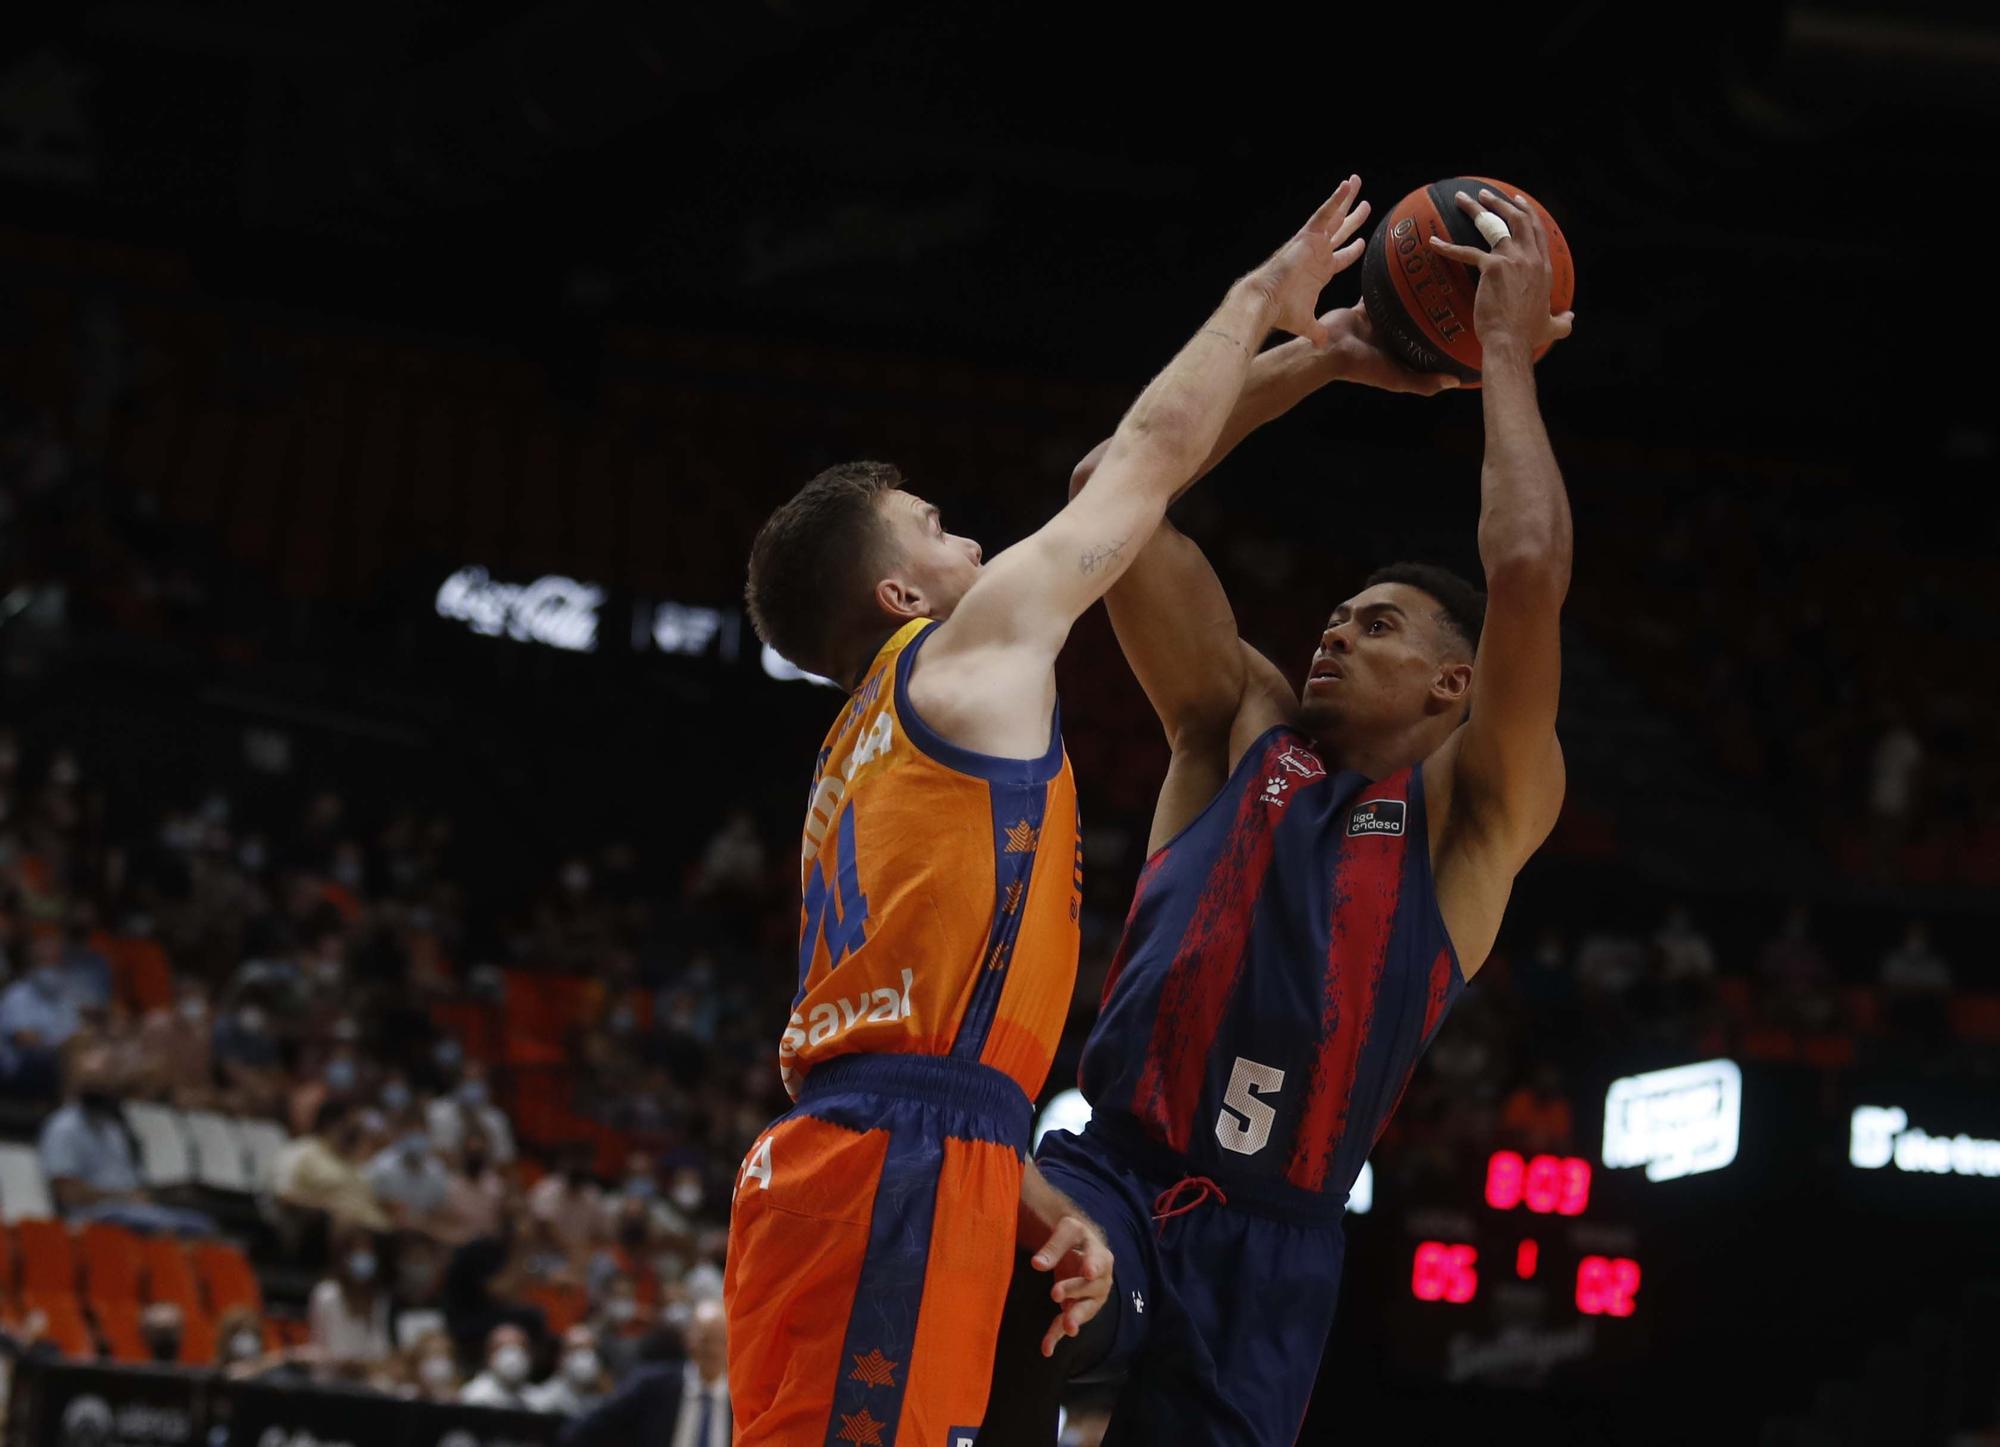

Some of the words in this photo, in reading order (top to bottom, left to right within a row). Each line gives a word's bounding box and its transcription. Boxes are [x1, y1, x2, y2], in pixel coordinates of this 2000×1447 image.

[1391, 217, 1465, 345] TF-1000
[1352, 819, 1400, 832] endesa
[1353, 812, 1375, 824] liga
[1214, 1056, 1286, 1156] 5
